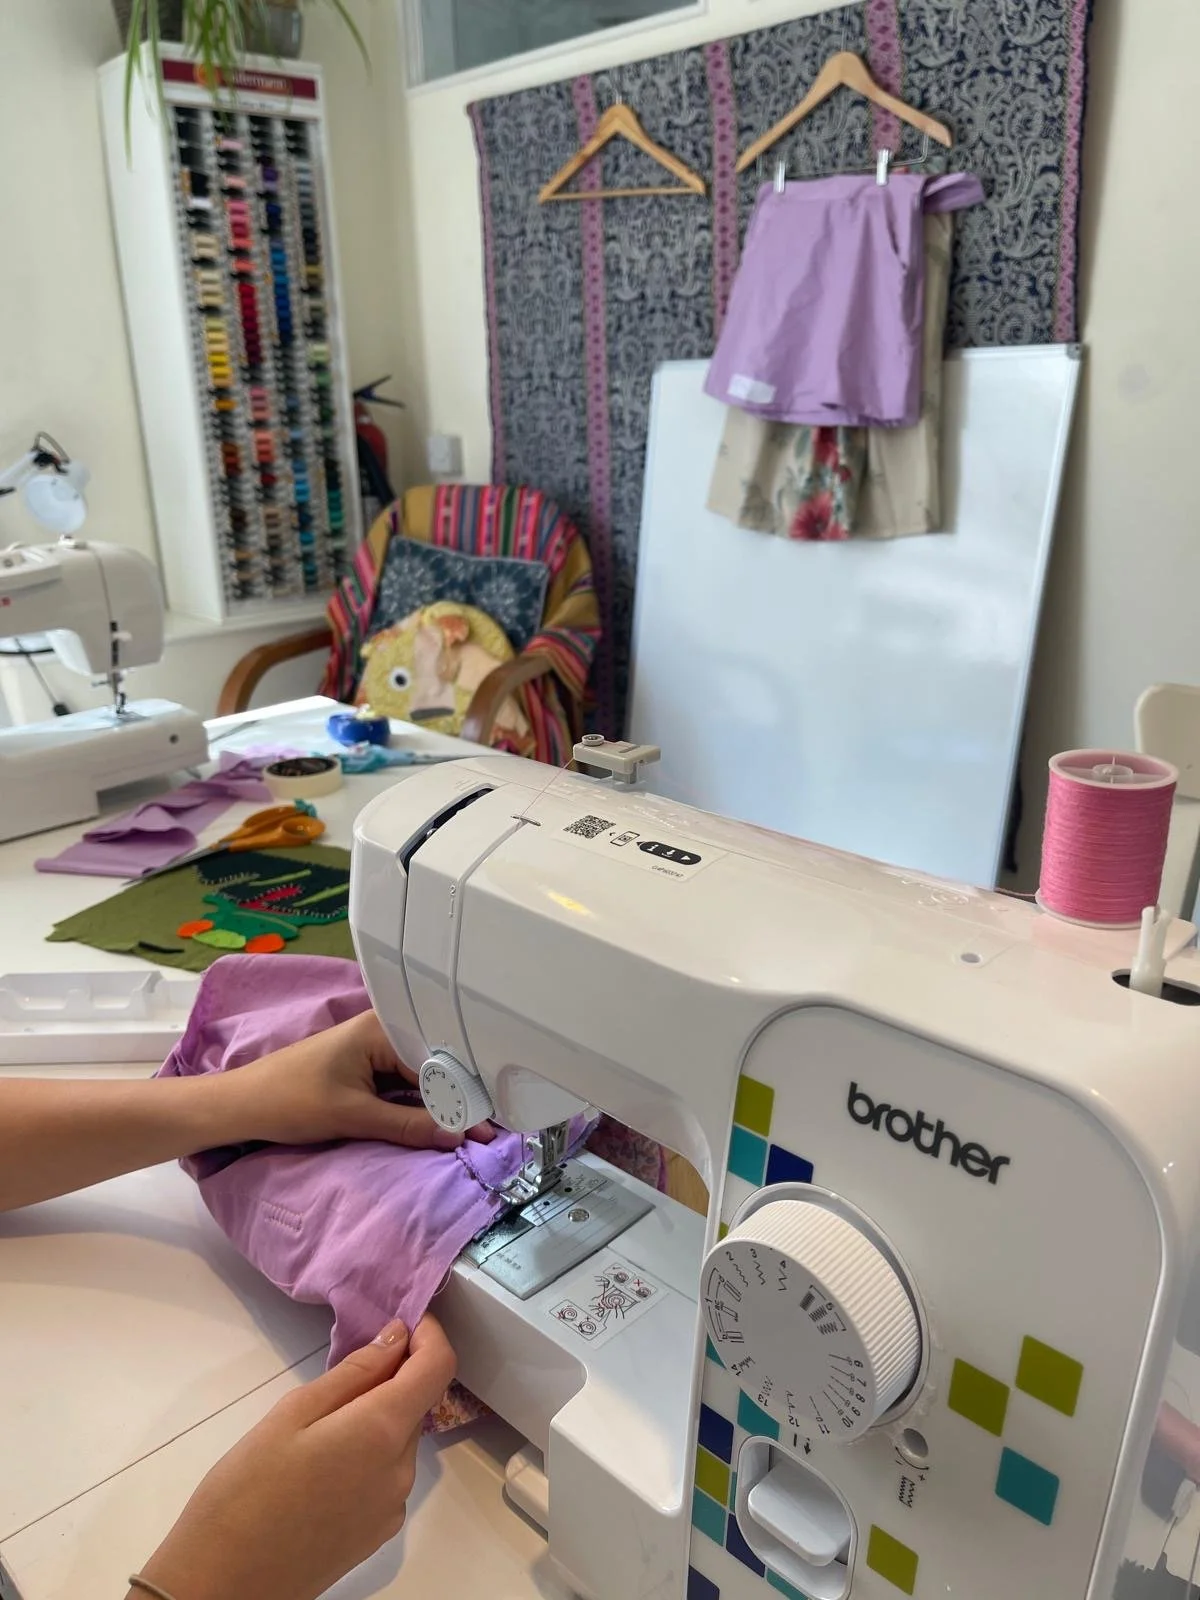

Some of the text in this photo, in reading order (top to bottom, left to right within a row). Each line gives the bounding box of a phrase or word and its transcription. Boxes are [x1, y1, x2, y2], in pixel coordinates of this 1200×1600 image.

[231, 71, 287, 90] termann
[847, 1081, 1011, 1185] brother
[726, 1251, 734, 1261] 2
[750, 1248, 757, 1258] 3
[780, 1260, 786, 1269] 4
[825, 1302, 834, 1311] 5
[854, 1360, 864, 1368] 6
[731, 1363, 742, 1377] 14
[856, 1378, 867, 1388] 7
[757, 1393, 769, 1407] 13
[855, 1393, 866, 1403] 8
[851, 1406, 861, 1417] 9
[788, 1414, 800, 1428] 12
[841, 1415, 854, 1428] 10
[818, 1423, 830, 1435] 11
